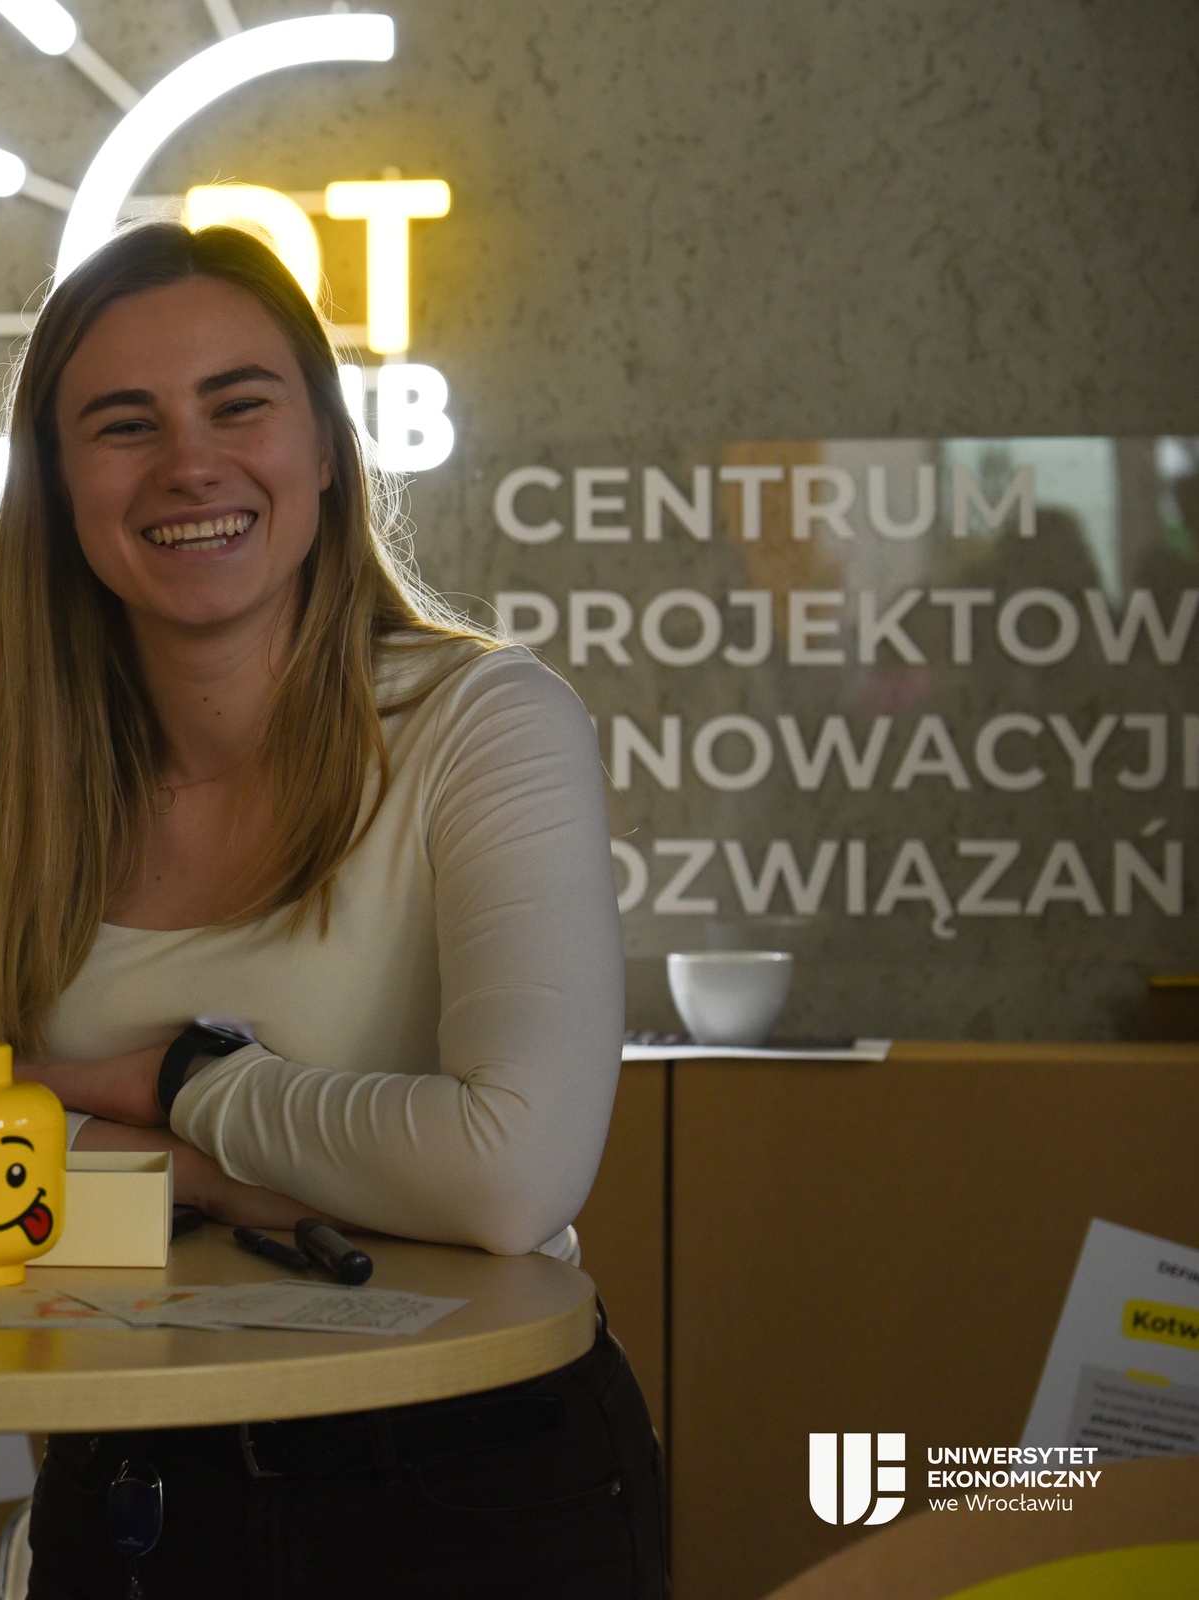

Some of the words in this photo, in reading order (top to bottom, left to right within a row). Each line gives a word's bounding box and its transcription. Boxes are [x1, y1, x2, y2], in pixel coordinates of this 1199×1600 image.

[493, 464, 1038, 543] CENTRUM
[495, 587, 1199, 667] PROJEKTOW
[590, 713, 1199, 790] NOWACYJ
[610, 818, 1185, 940] ZWIĄZAŃ
